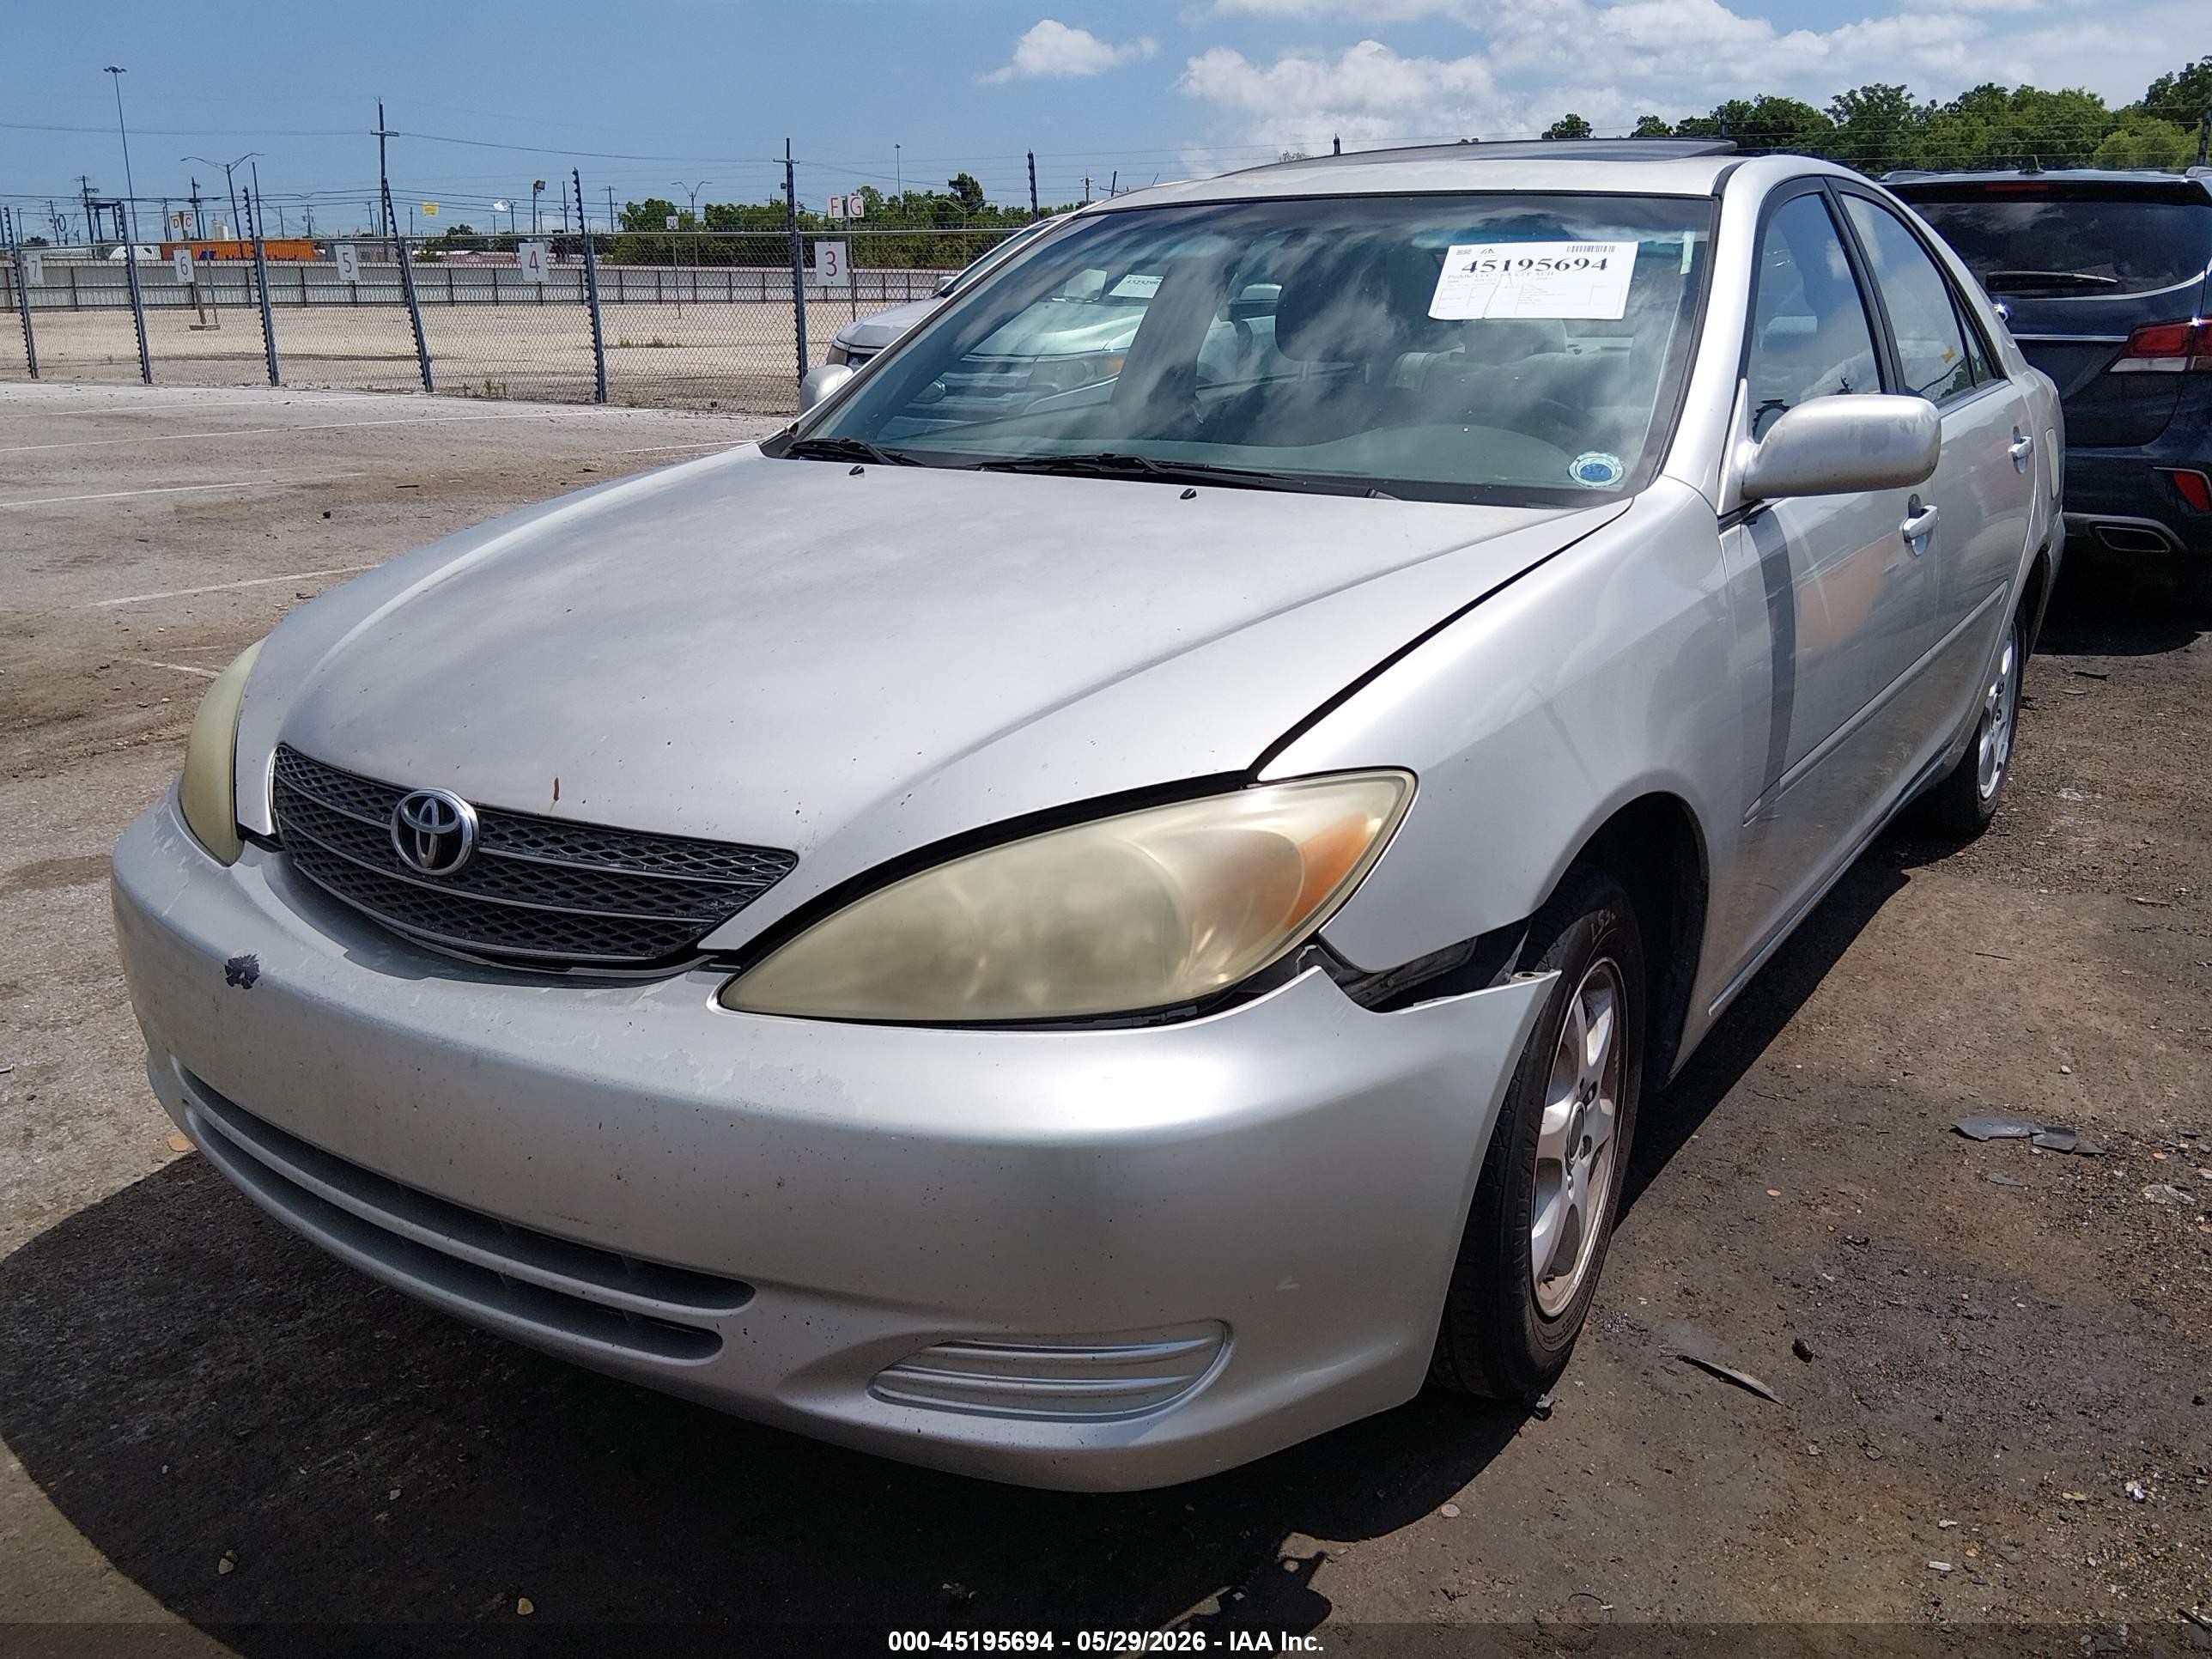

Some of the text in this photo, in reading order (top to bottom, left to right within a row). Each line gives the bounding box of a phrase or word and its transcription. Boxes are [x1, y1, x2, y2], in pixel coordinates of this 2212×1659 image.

[830, 197, 839, 216] F
[850, 197, 862, 216] G
[173, 218, 179, 228] D
[185, 216, 192, 228] C
[667, 218, 678, 228] 20
[31, 260, 38, 278] 7
[180, 256, 189, 276] 6
[342, 252, 352, 273] 5
[529, 250, 540, 274] 4
[824, 251, 838, 276] 3
[1462, 257, 1609, 274] 45195694
